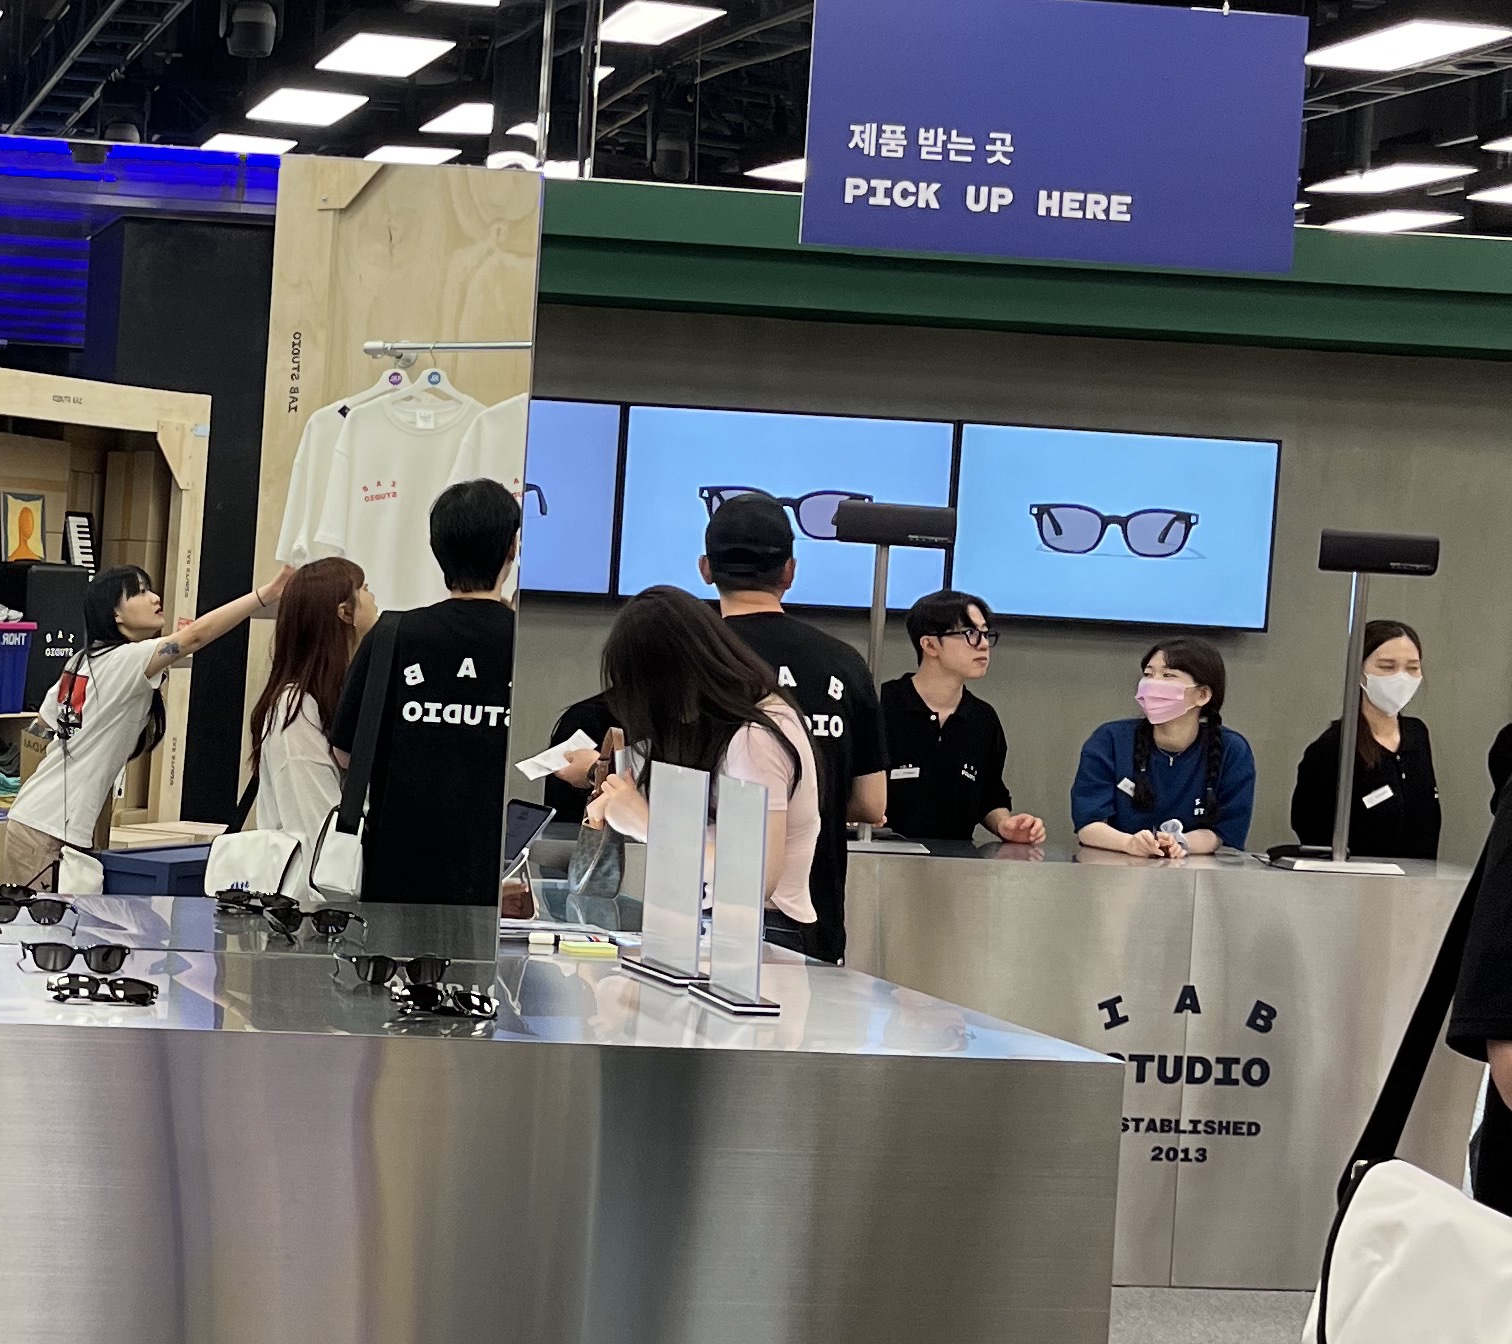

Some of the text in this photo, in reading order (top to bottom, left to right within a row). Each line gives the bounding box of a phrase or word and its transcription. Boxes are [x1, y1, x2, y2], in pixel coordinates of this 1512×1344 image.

[848, 122, 1014, 165] 제품 받는 곳
[844, 177, 1133, 222] PICK UP HERE
[1121, 1117, 1261, 1136] STABLISHED
[1150, 1146, 1207, 1163] 2013
